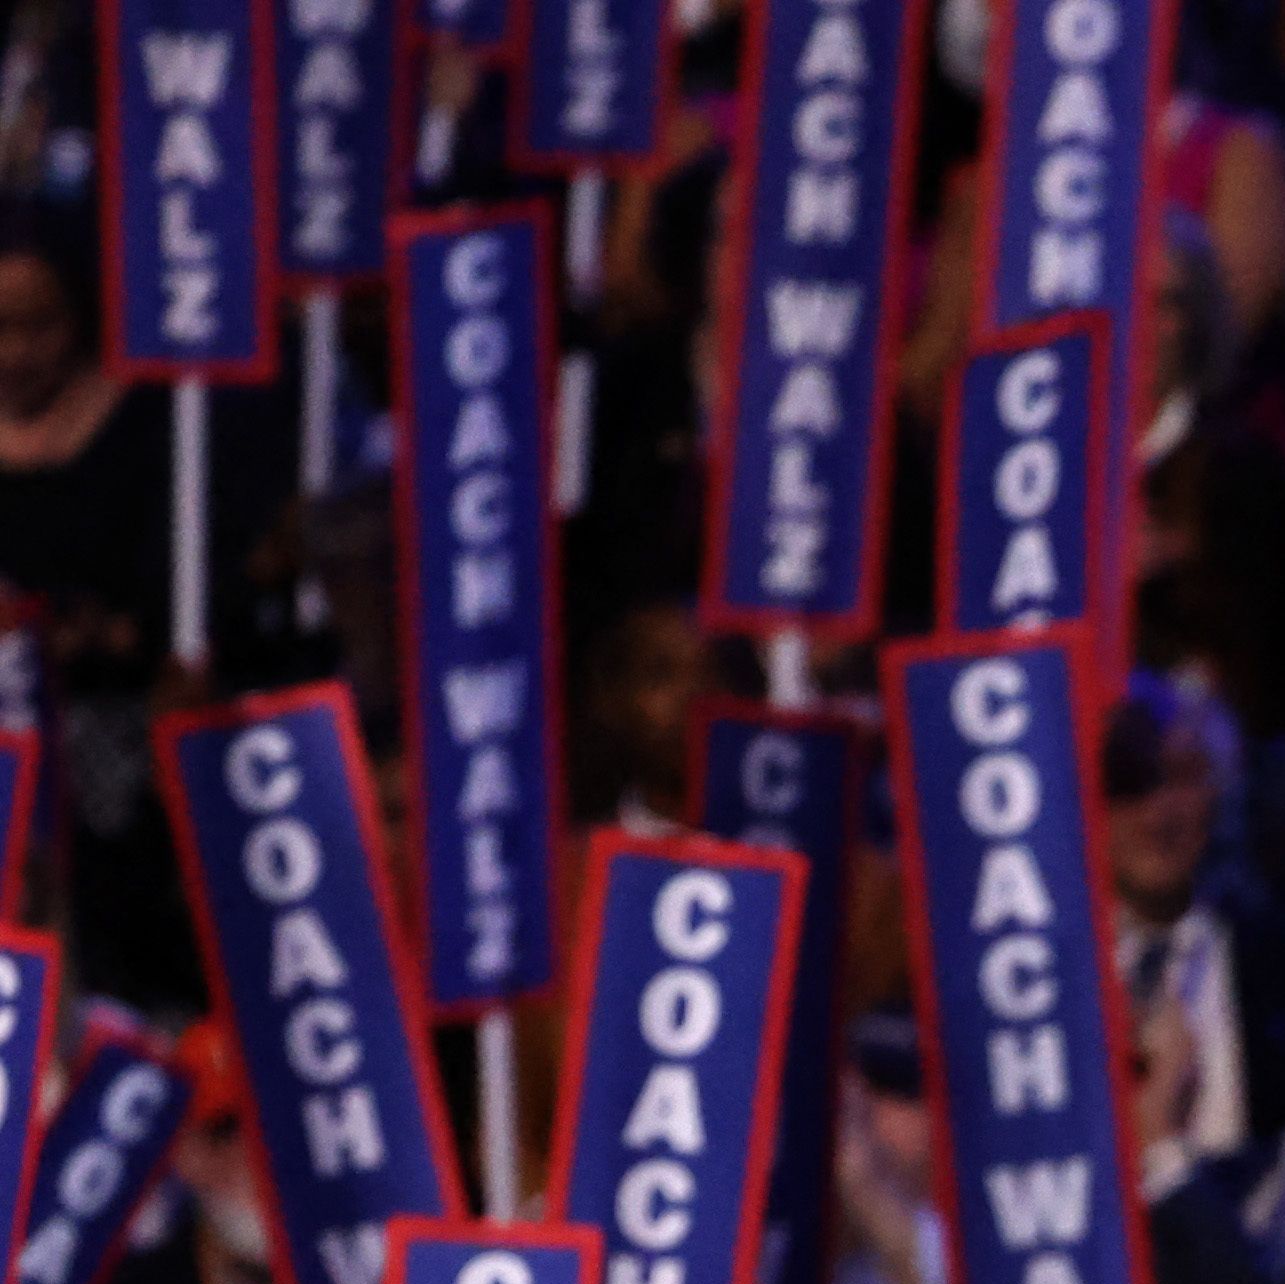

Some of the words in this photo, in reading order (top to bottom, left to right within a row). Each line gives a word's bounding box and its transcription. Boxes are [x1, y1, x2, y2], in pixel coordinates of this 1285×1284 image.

[141, 33, 229, 343] WALZ
[783, 0, 870, 245] ACH
[1028, 0, 1119, 302] OACH
[441, 233, 516, 628] COACH
[759, 279, 864, 597] WALZ
[989, 348, 1063, 637] COA
[225, 724, 385, 1177] COACH
[442, 660, 529, 981] WALZ
[950, 657, 1071, 1116] COACH
